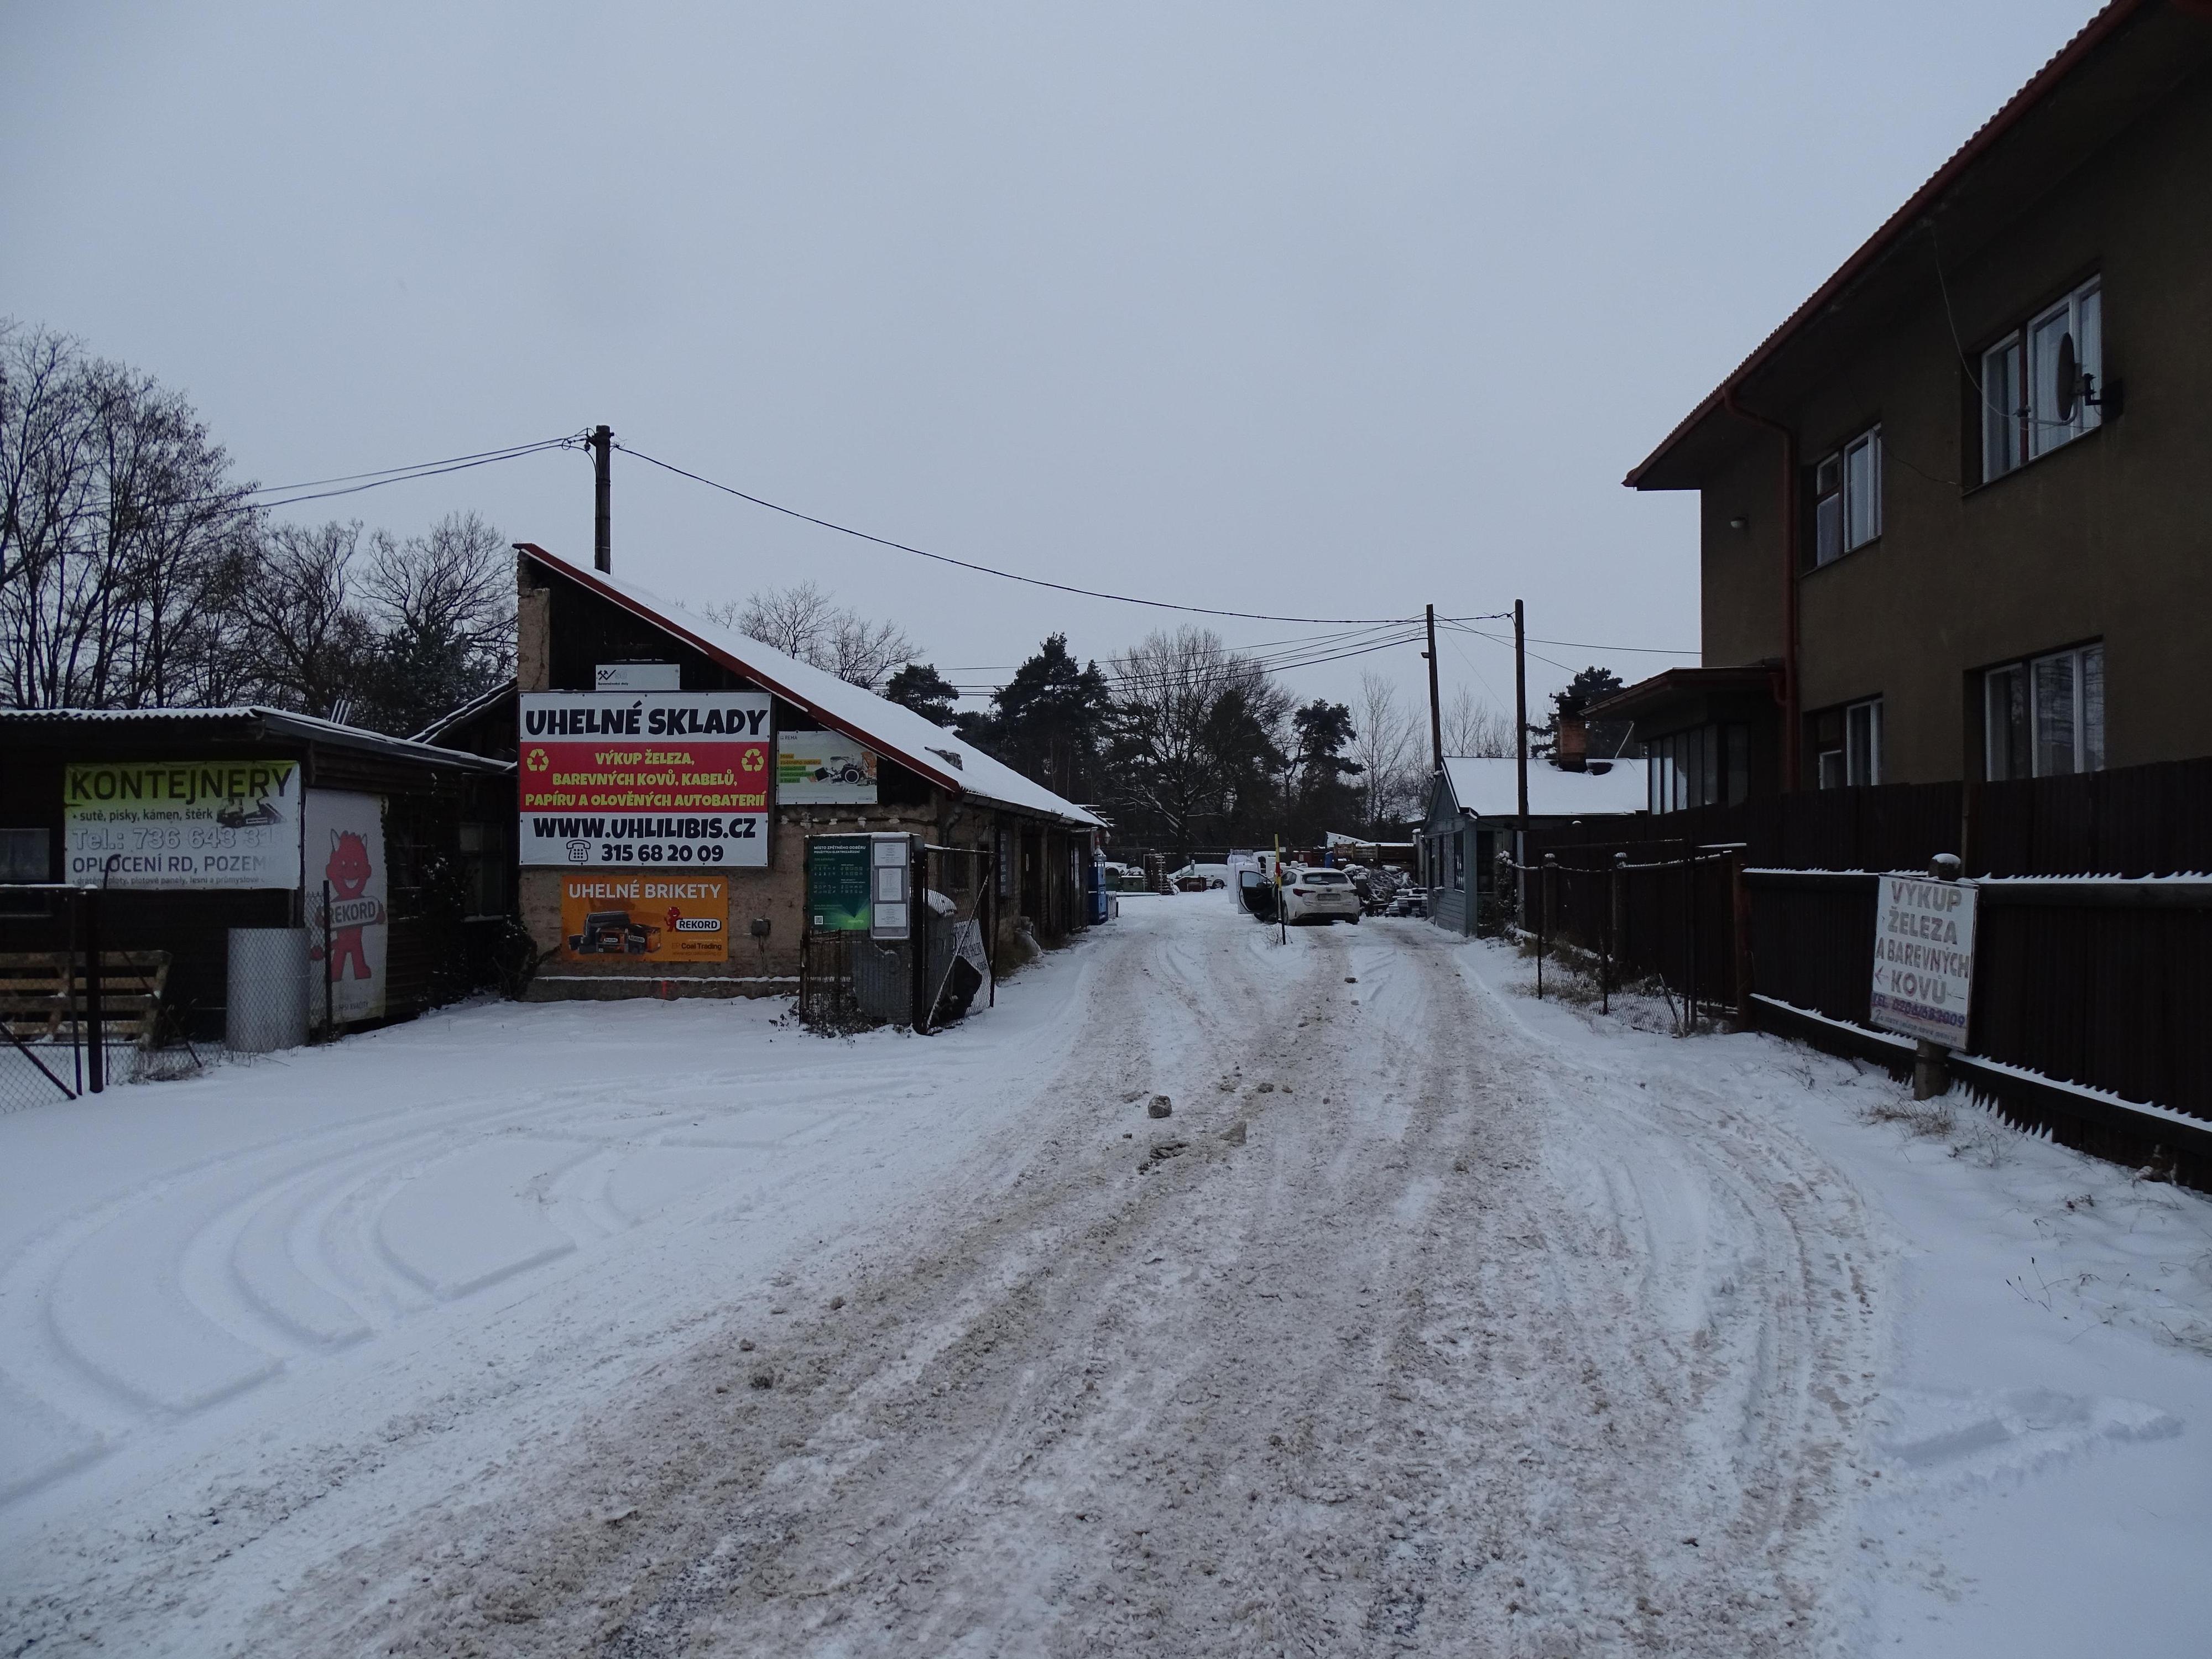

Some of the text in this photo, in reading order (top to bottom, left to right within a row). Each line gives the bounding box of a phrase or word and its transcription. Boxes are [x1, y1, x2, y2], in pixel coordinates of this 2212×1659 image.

[526, 700, 768, 735] UHELNÉ SKLADY
[595, 749, 695, 766] VÝKUP ŽELEZA,
[71, 768, 292, 805] KONTEJNERY
[552, 769, 738, 786] BAREVNÝCH KOVŮ, KABELŮ,
[525, 790, 766, 807] PAPÍRU A OLOVĚNÝCH AUTOBATERIÍ
[80, 808, 213, 822] sutě, písky, kámen, štěrk
[533, 817, 757, 838] WWW.UHLILIBIS.CZ
[72, 828, 124, 851] Tel.:
[133, 827, 180, 850] 736
[188, 827, 236, 849] 643
[72, 853, 162, 873] OPLOCENÍ
[169, 857, 198, 874] RD,
[601, 844, 724, 862] 315 68 20 09
[569, 879, 722, 899] UHELNÉ BRIKETY
[1891, 880, 1962, 912] VÝKUP
[679, 920, 718, 930] REKORD
[1888, 906, 1958, 945] ŽELEZA
[697, 942, 722, 951] Trading
[1875, 937, 1970, 979] A BAREVNÝCH
[1891, 969, 1947, 1004] KOVŮ
